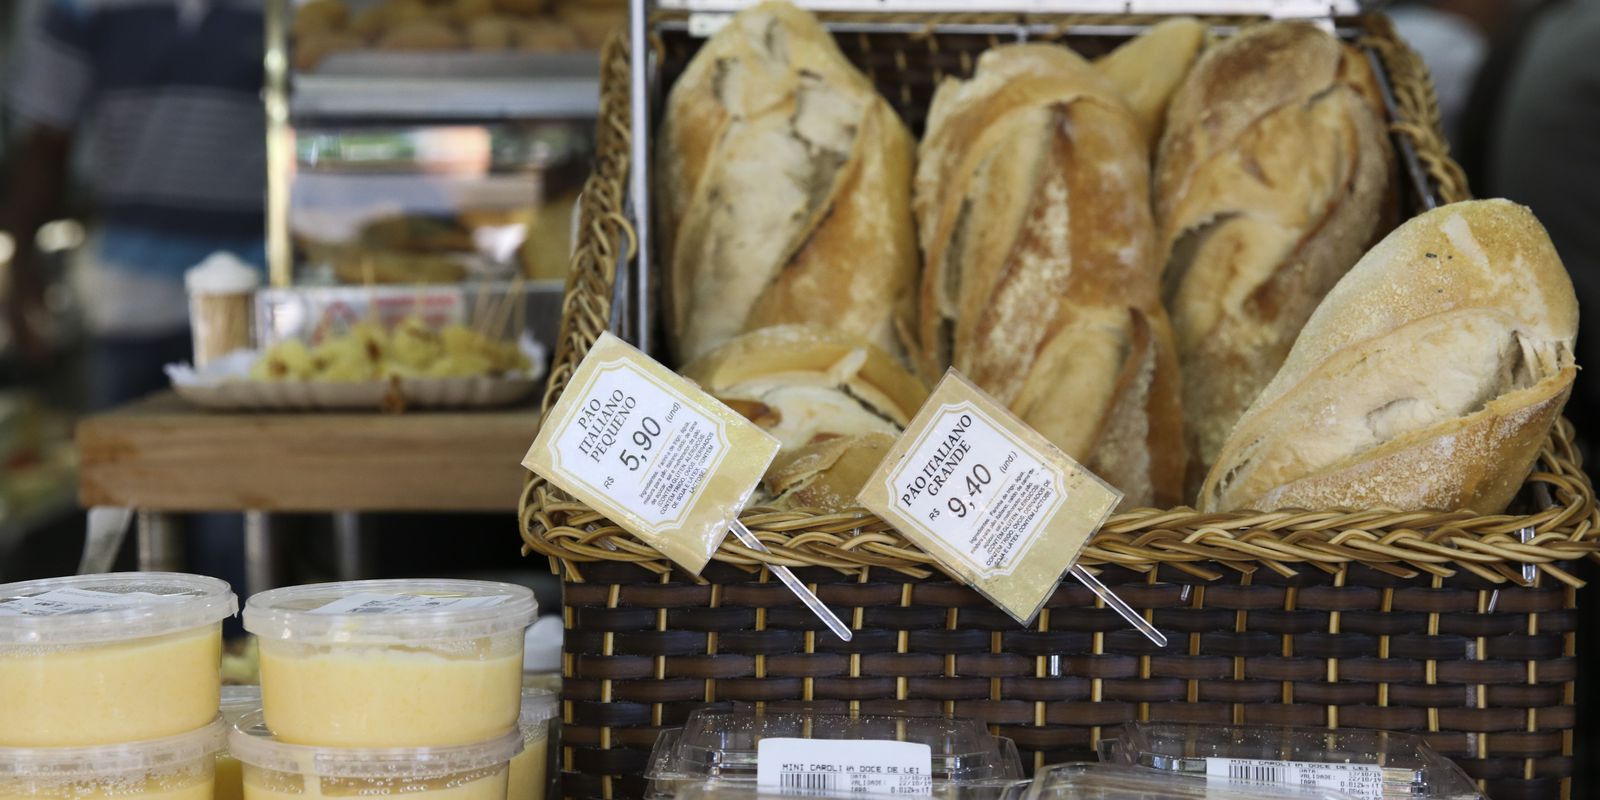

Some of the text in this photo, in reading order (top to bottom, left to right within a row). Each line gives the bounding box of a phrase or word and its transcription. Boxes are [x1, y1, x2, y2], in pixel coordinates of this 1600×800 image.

[577, 398, 601, 430] PÃO
[578, 389, 624, 455] ITALIANO
[664, 401, 682, 424] (und)
[590, 396, 636, 463] PEQUENO
[603, 416, 661, 489] R$ 5,90
[693, 431, 714, 461] DERIVADOS
[901, 414, 972, 507] PÃO ITALIANO
[999, 450, 1018, 474] (und.)
[927, 439, 971, 496] GRANDE
[671, 501, 679, 509] DE
[676, 488, 688, 502] SOJA
[928, 463, 992, 521] R$ 9,40
[1023, 486, 1046, 515] DERIVADOS
[782, 763, 804, 772] MINI
[859, 765, 882, 773] DOCE
[887, 766, 898, 774] DE
